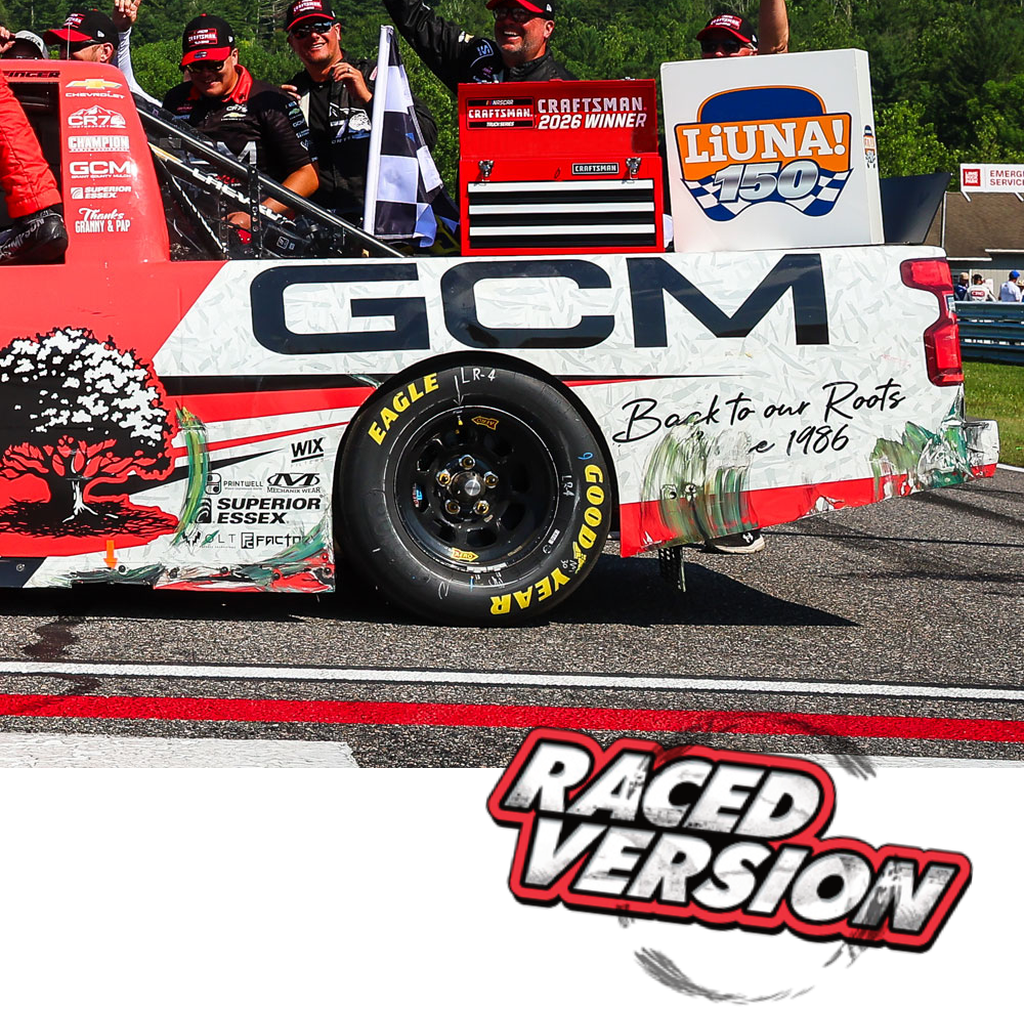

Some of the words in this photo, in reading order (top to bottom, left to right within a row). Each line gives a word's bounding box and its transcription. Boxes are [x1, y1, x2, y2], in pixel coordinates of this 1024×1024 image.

[65, 91, 125, 99] CHEVROLET
[537, 97, 643, 113] CRAFTSMAN
[68, 115, 111, 126] CR7
[468, 108, 533, 119] CRAFTSMAN
[538, 114, 582, 130] 2026
[584, 113, 647, 128] WINNER
[68, 135, 130, 149] CHAMPION
[683, 119, 846, 164] LiUNA!
[69, 160, 131, 175] GCM
[575, 164, 617, 173] CRAFTSMAN
[990, 170, 1024, 178] EMERG
[713, 159, 820, 203] 150
[78, 207, 125, 222] Thanks
[75, 220, 105, 233] GRANNY
[107, 220, 114, 232] &
[116, 219, 131, 232] PAP
[249, 253, 830, 355] GCM
[460, 366, 496, 384] LR-4
[368, 372, 440, 446] EAGLE
[612, 397, 719, 444] Back
[727, 392, 757, 425] to
[763, 401, 813, 422] our
[821, 378, 907, 423] Roots
[786, 423, 851, 456] 1986
[291, 437, 324, 458] WIX
[223, 480, 264, 488] PRINTWELL
[267, 486, 301, 494] MECHANIX
[302, 486, 321, 494] WEAR
[217, 498, 322, 510] SUPERIOR
[217, 512, 288, 524] ESSEX
[490, 464, 605, 615] GOODYEAR
